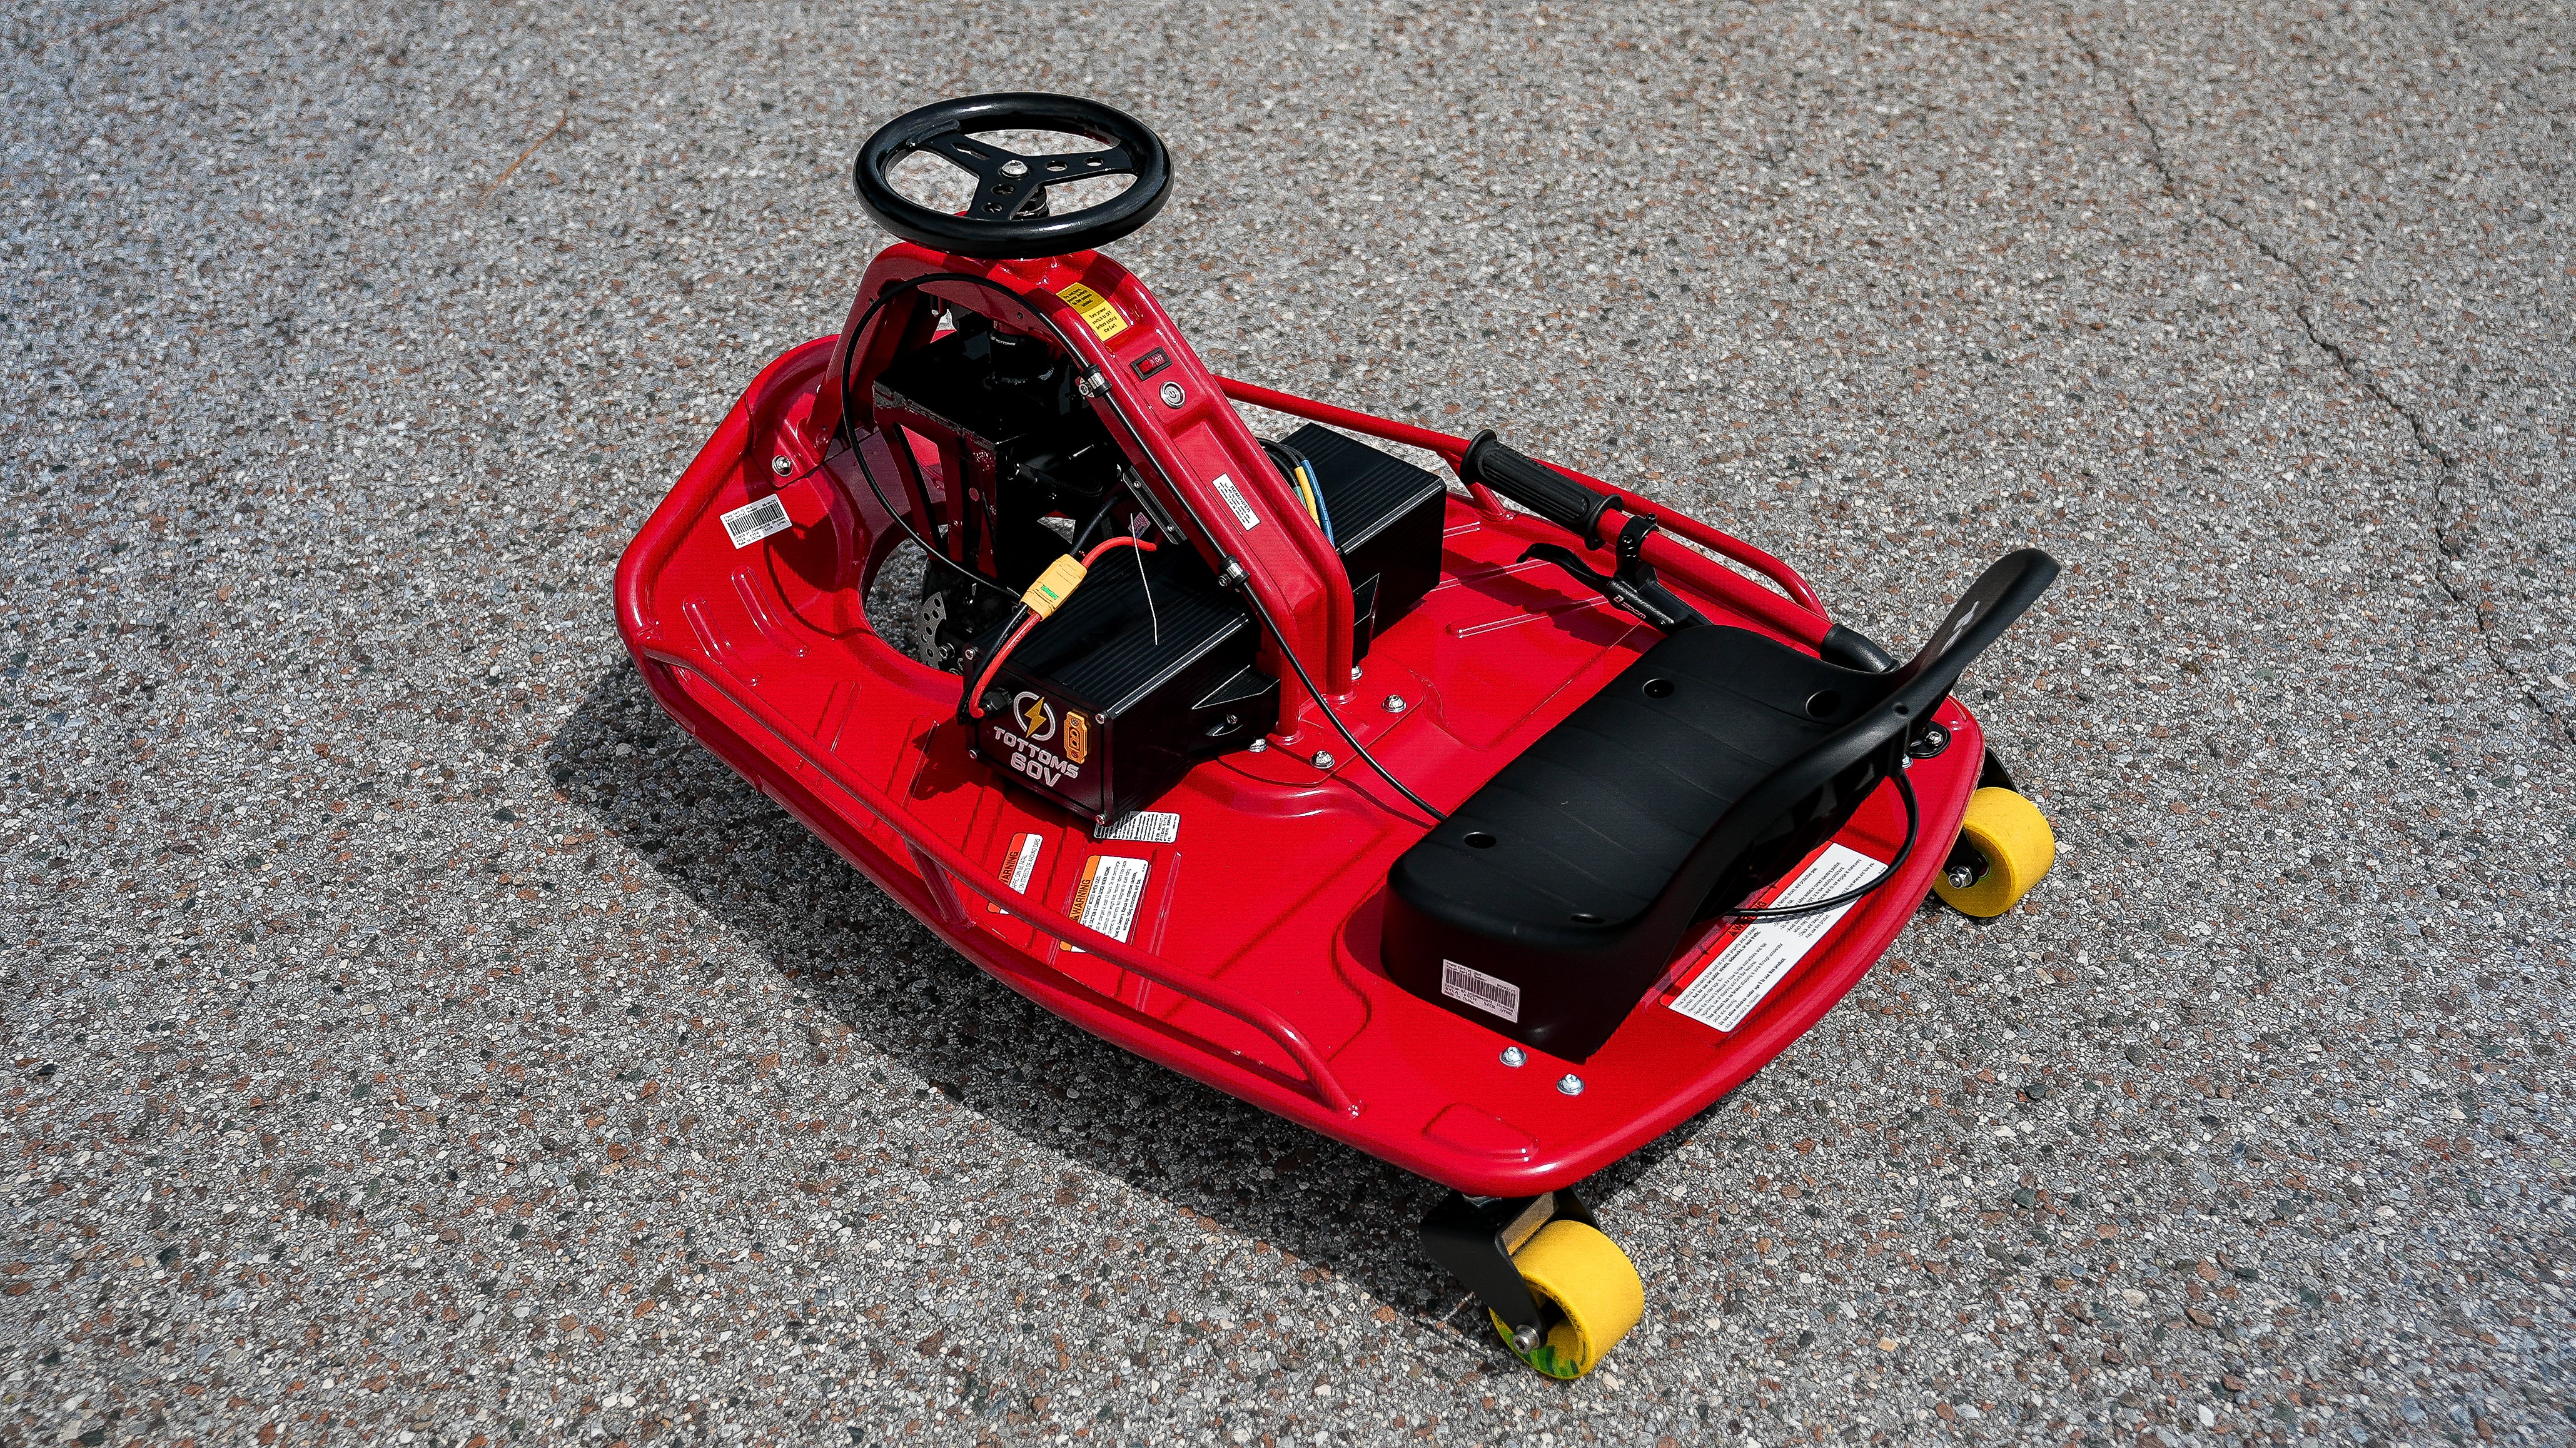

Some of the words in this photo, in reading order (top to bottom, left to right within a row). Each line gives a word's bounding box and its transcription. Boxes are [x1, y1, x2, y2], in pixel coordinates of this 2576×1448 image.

[1230, 486, 1250, 513] REMINDER
[993, 726, 1079, 779] TOTTOMS
[1011, 752, 1061, 787] 60V
[1071, 878, 1091, 916] WARNING
